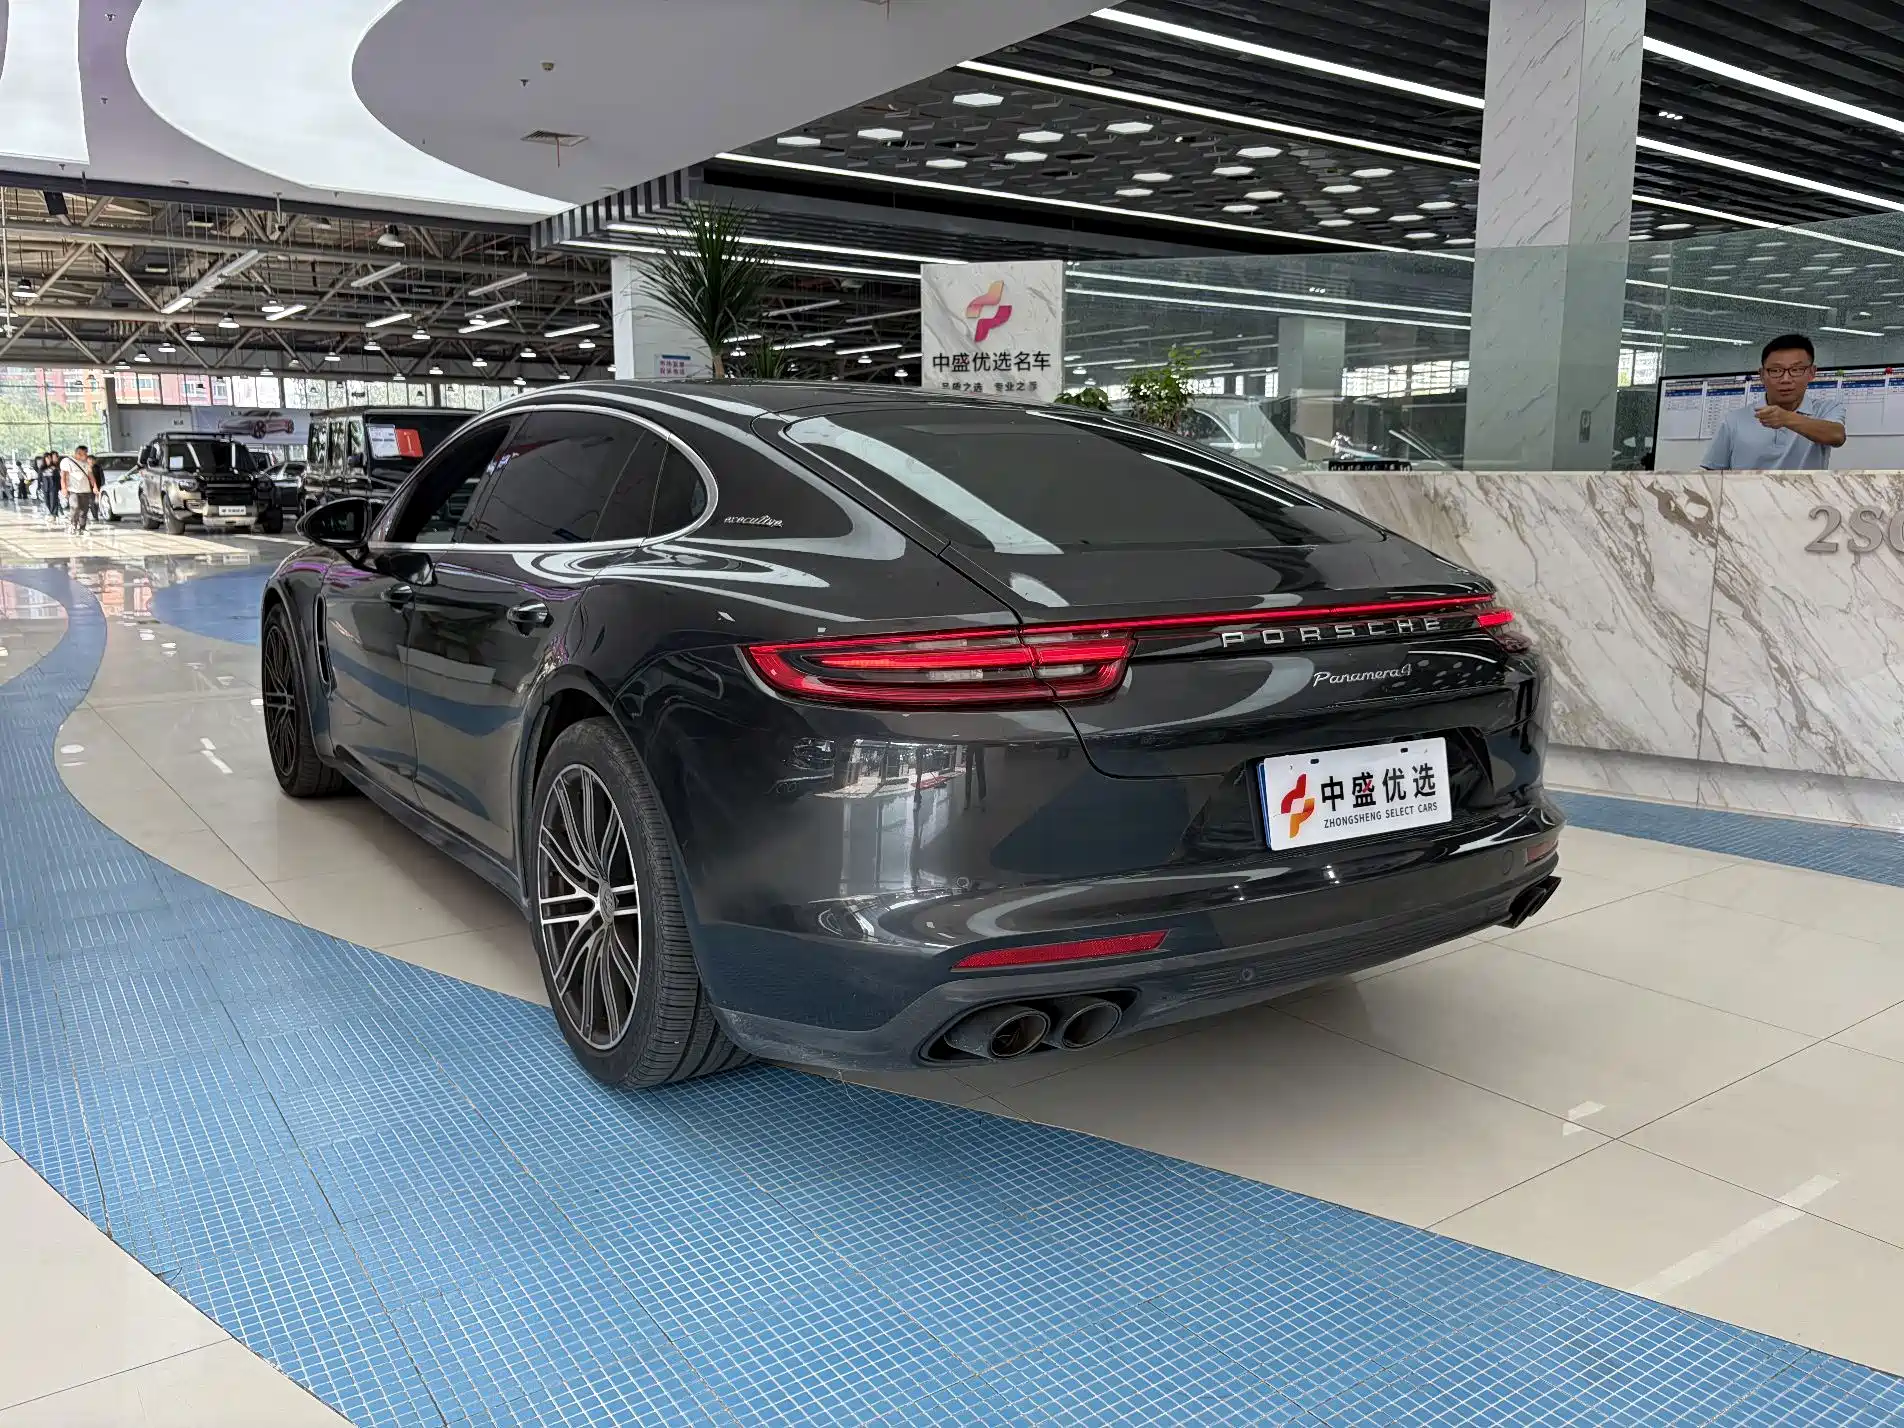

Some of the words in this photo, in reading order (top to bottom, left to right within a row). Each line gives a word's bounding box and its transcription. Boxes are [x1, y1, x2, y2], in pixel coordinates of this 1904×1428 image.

[932, 351, 1051, 373] 中盛优选名车
[1221, 617, 1441, 648] PORSCHE
[1320, 762, 1437, 812] 中盛优选
[1323, 810, 1382, 829] ZHONGSHENG
[1385, 803, 1415, 819] SELECT
[1418, 801, 1438, 813] CARS
